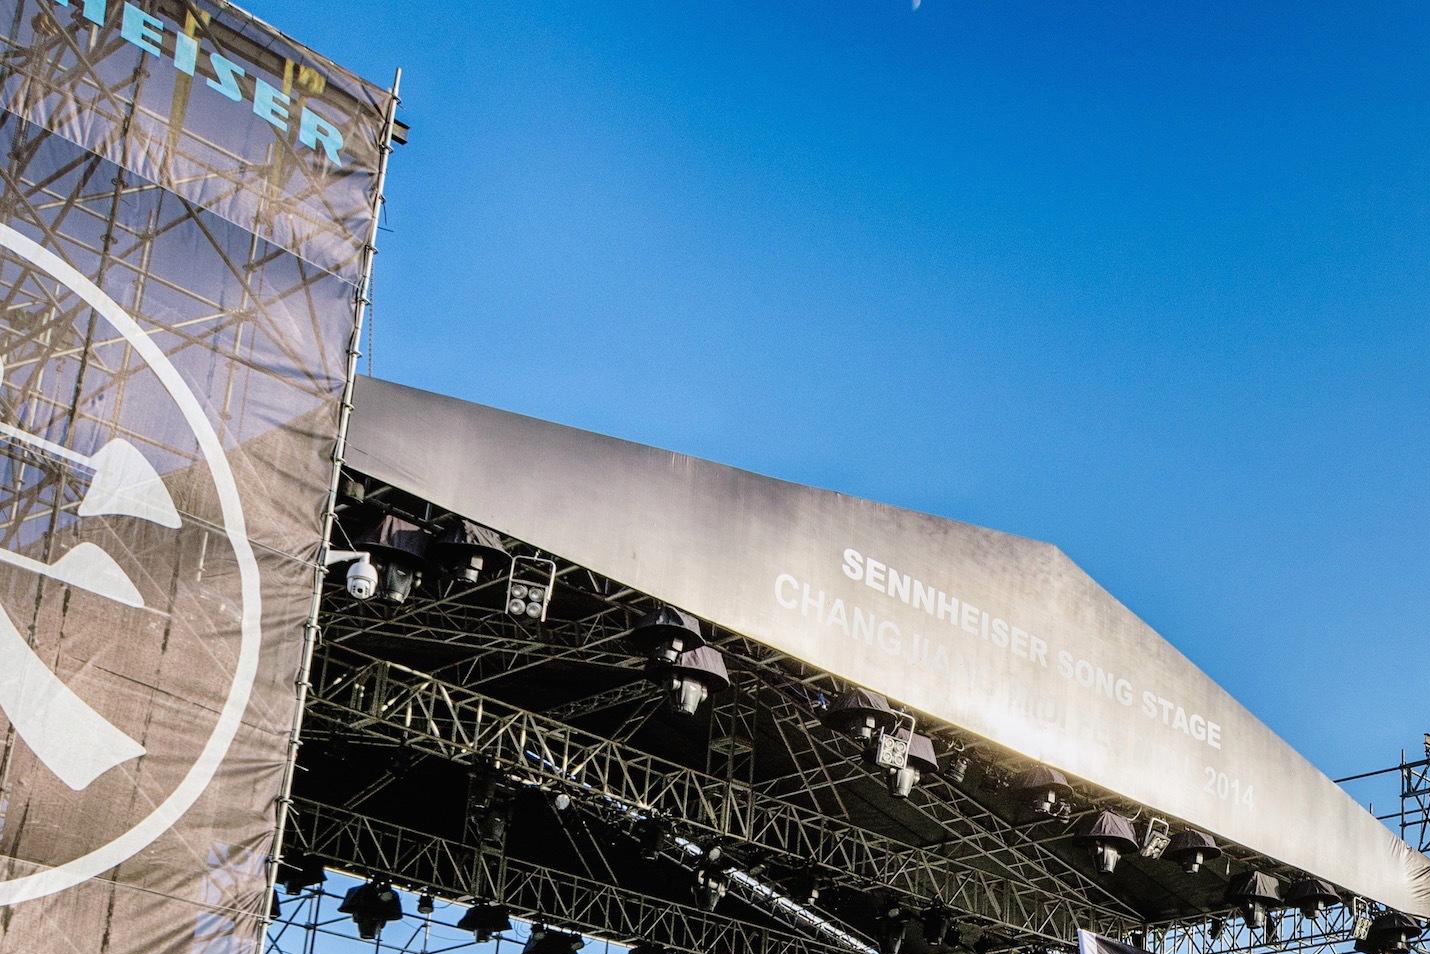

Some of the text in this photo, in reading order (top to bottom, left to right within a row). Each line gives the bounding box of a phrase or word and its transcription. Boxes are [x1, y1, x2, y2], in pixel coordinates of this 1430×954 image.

[54, 0, 344, 167] EISER
[842, 548, 1049, 668] SENNHEISER
[1056, 649, 1133, 706] SONG
[1141, 689, 1222, 751] STAGE
[1202, 766, 1256, 812] 2014
